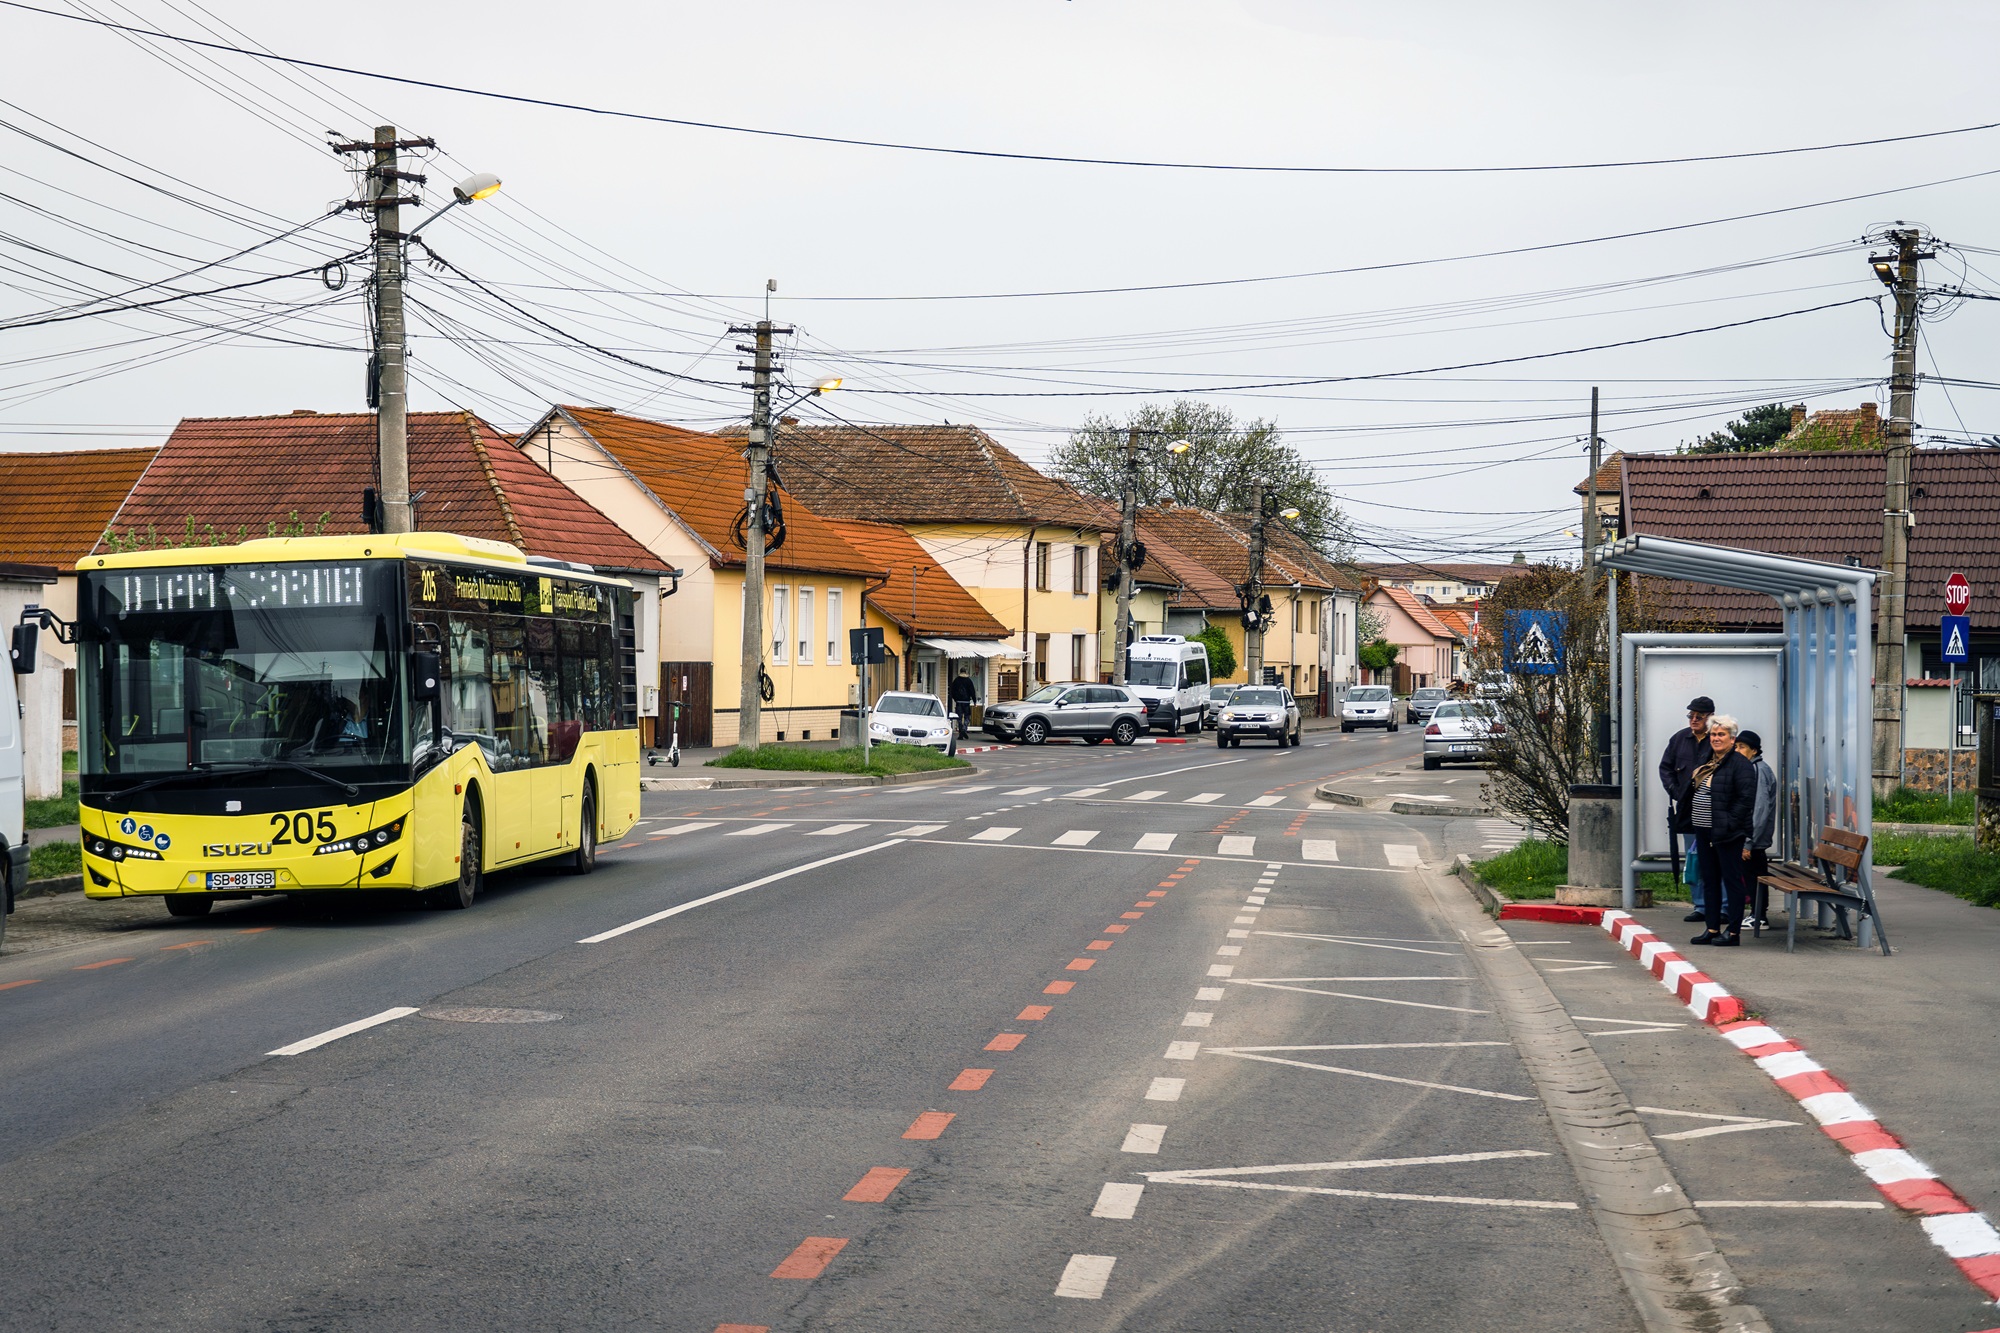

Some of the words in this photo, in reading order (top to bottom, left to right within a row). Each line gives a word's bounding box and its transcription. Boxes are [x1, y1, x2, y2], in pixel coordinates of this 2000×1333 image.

[421, 569, 437, 602] 205
[479, 577, 509, 606] Municipiului
[509, 580, 522, 602] Sibiu
[1946, 585, 1969, 604] STOP
[270, 811, 337, 845] 205
[203, 842, 272, 857] ISUZU
